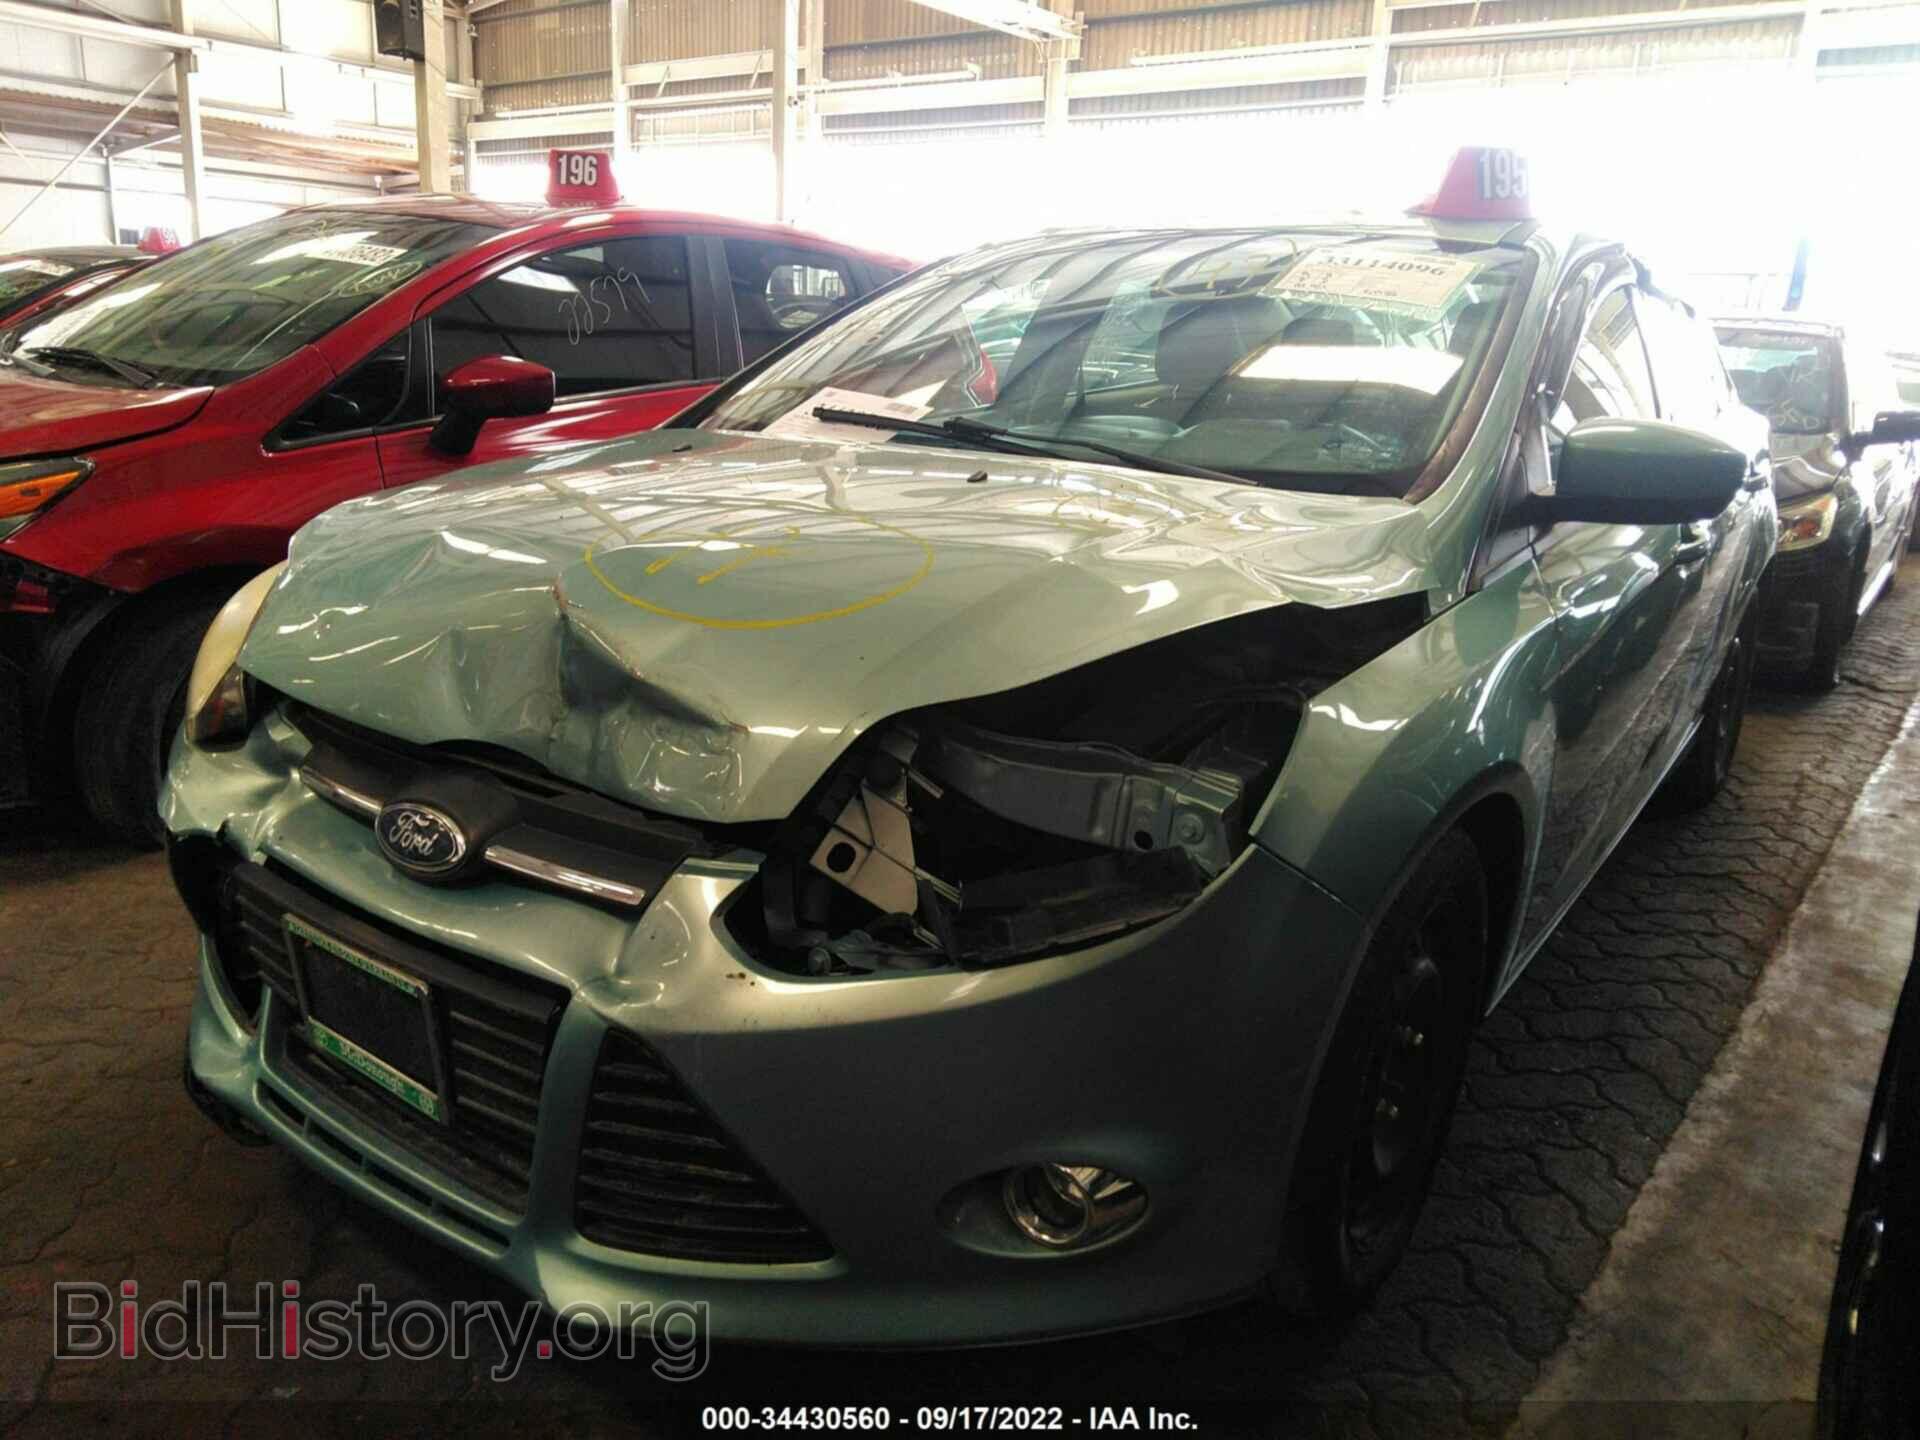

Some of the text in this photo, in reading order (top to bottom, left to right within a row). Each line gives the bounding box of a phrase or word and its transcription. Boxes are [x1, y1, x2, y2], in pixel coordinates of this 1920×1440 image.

[558, 154, 598, 186] 196
[1479, 149, 1528, 200] 195
[389, 811, 440, 856] Ford
